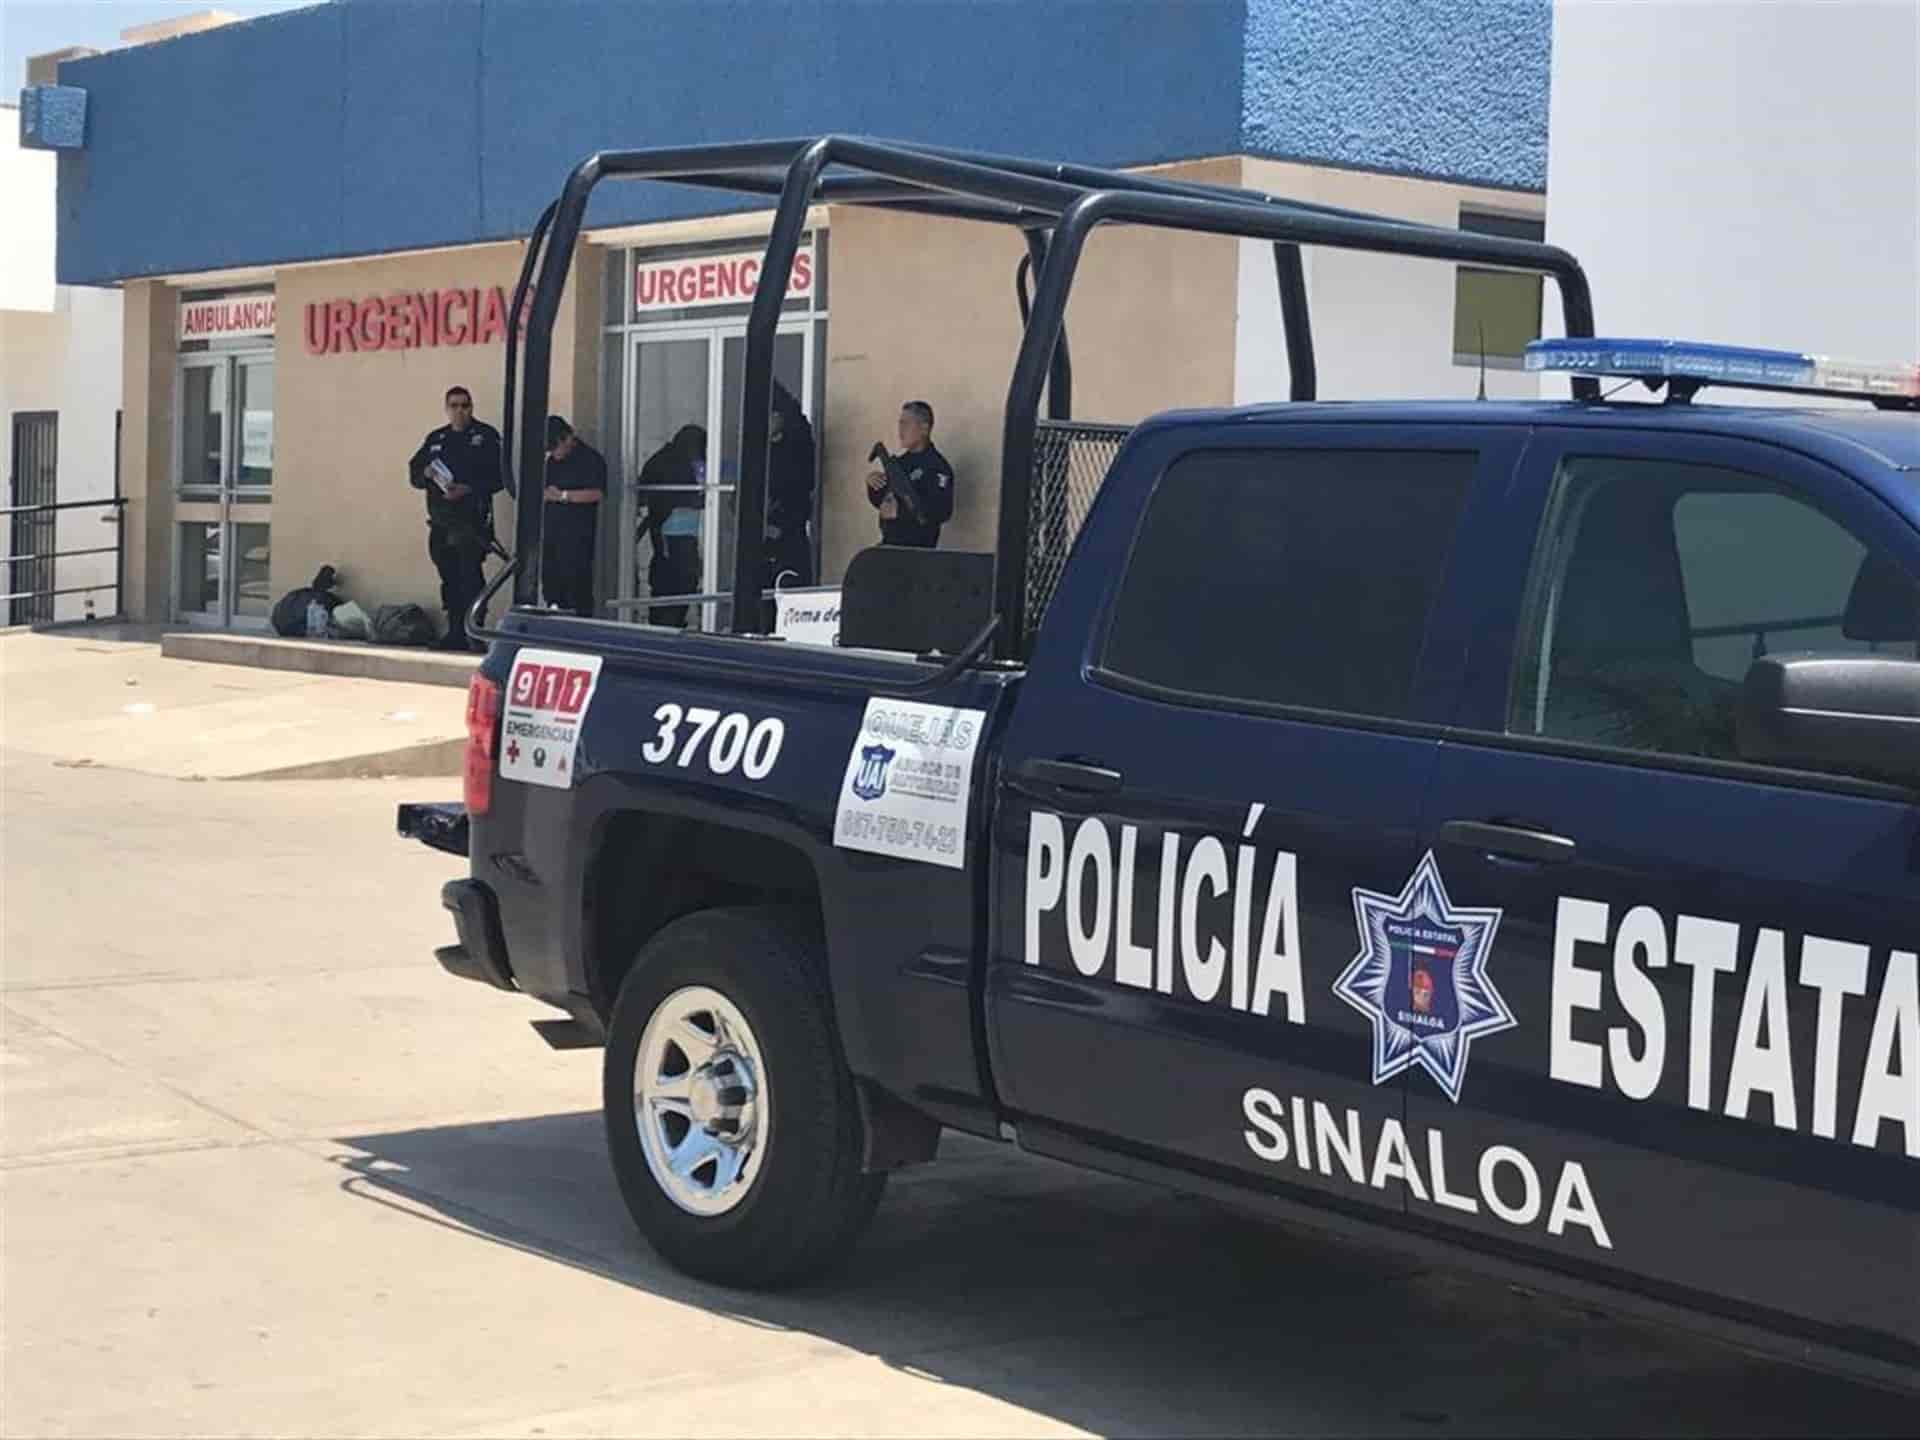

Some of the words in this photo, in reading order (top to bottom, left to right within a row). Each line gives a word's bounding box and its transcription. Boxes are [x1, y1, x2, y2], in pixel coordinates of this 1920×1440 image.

[637, 253, 811, 304] URGENCS
[304, 285, 538, 355] URGENCIA
[516, 671, 583, 714] 911
[506, 719, 576, 743] EMERGENCIAS
[642, 703, 785, 780] 3700
[867, 710, 975, 750] QUEJAS
[1024, 803, 1306, 1025] POLICÍA
[1549, 895, 1920, 1158] ESTATA
[1398, 1009, 1445, 1030] SINALOA
[1242, 1088, 1613, 1250] SINALOA
